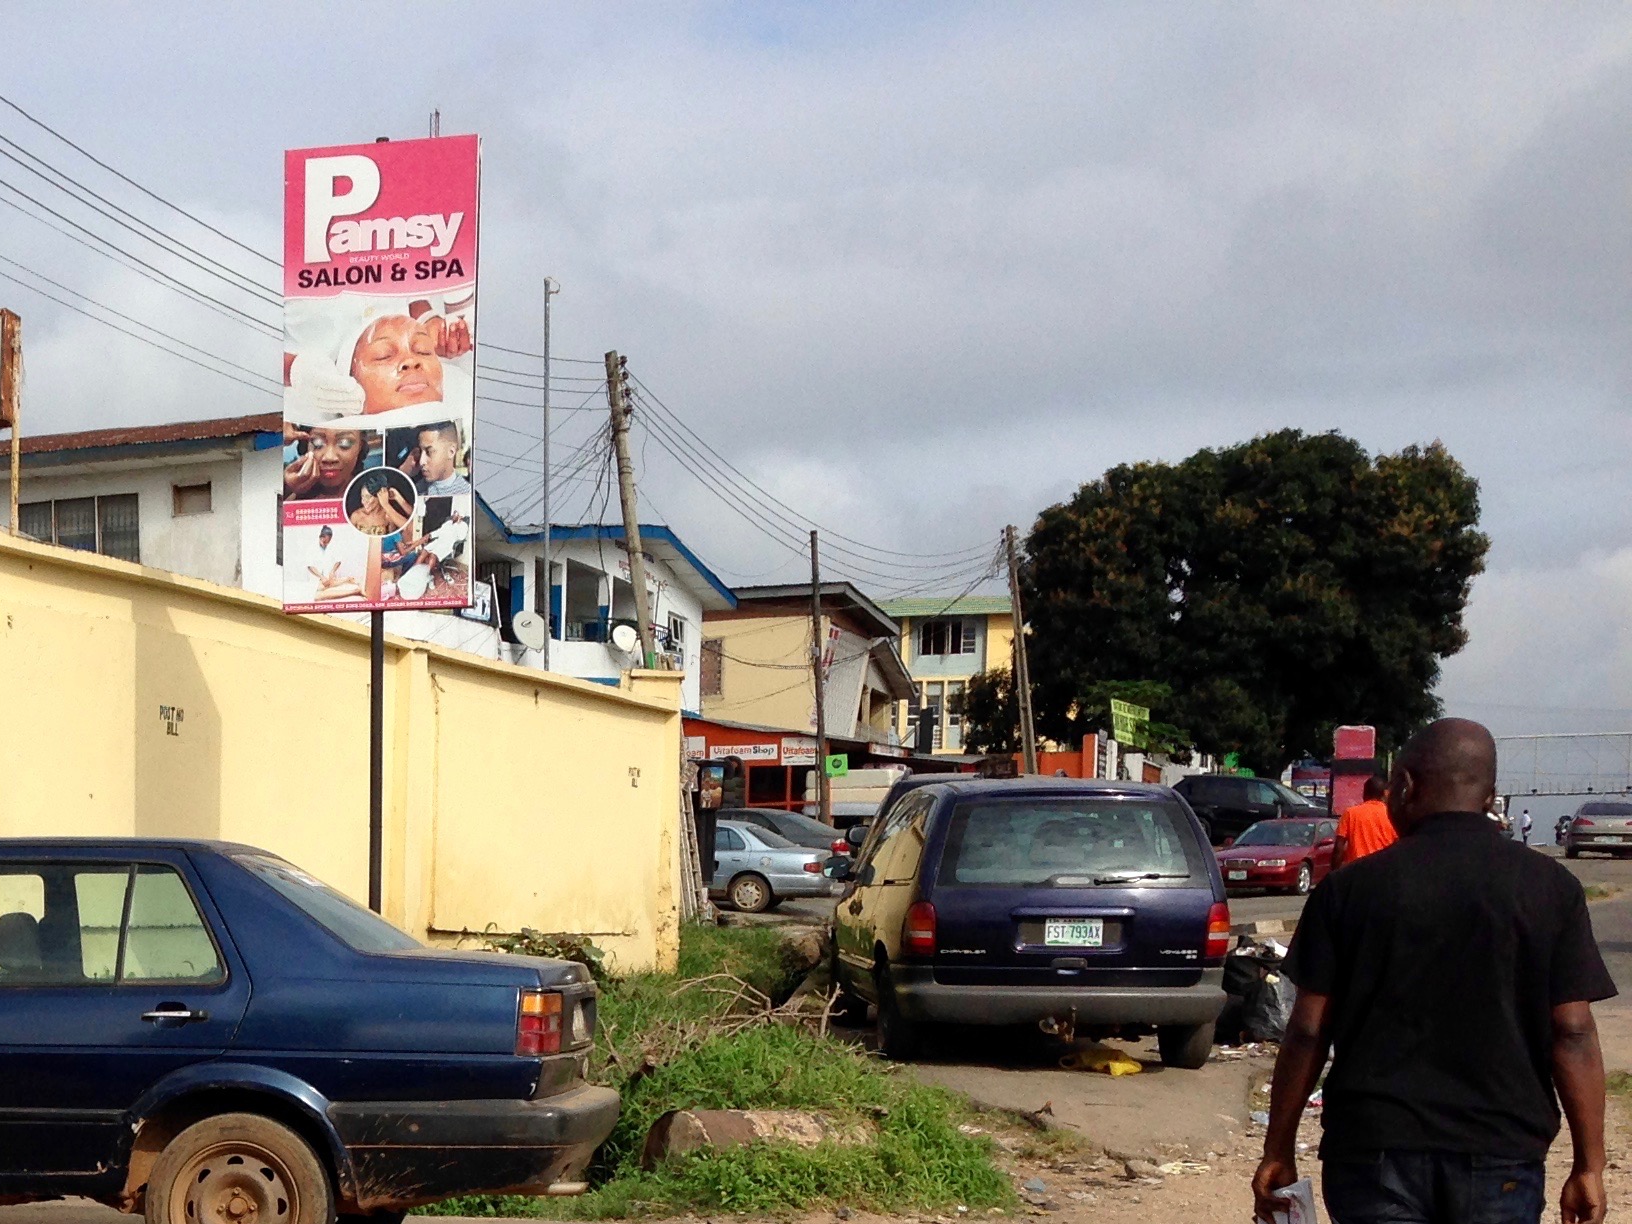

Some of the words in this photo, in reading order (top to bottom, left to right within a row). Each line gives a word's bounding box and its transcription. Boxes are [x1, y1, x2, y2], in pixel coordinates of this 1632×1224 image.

[304, 154, 465, 264] Pamsy
[297, 264, 382, 288] SALON
[390, 263, 408, 282] &
[414, 258, 465, 280] SPA
[753, 746, 774, 755] Shop
